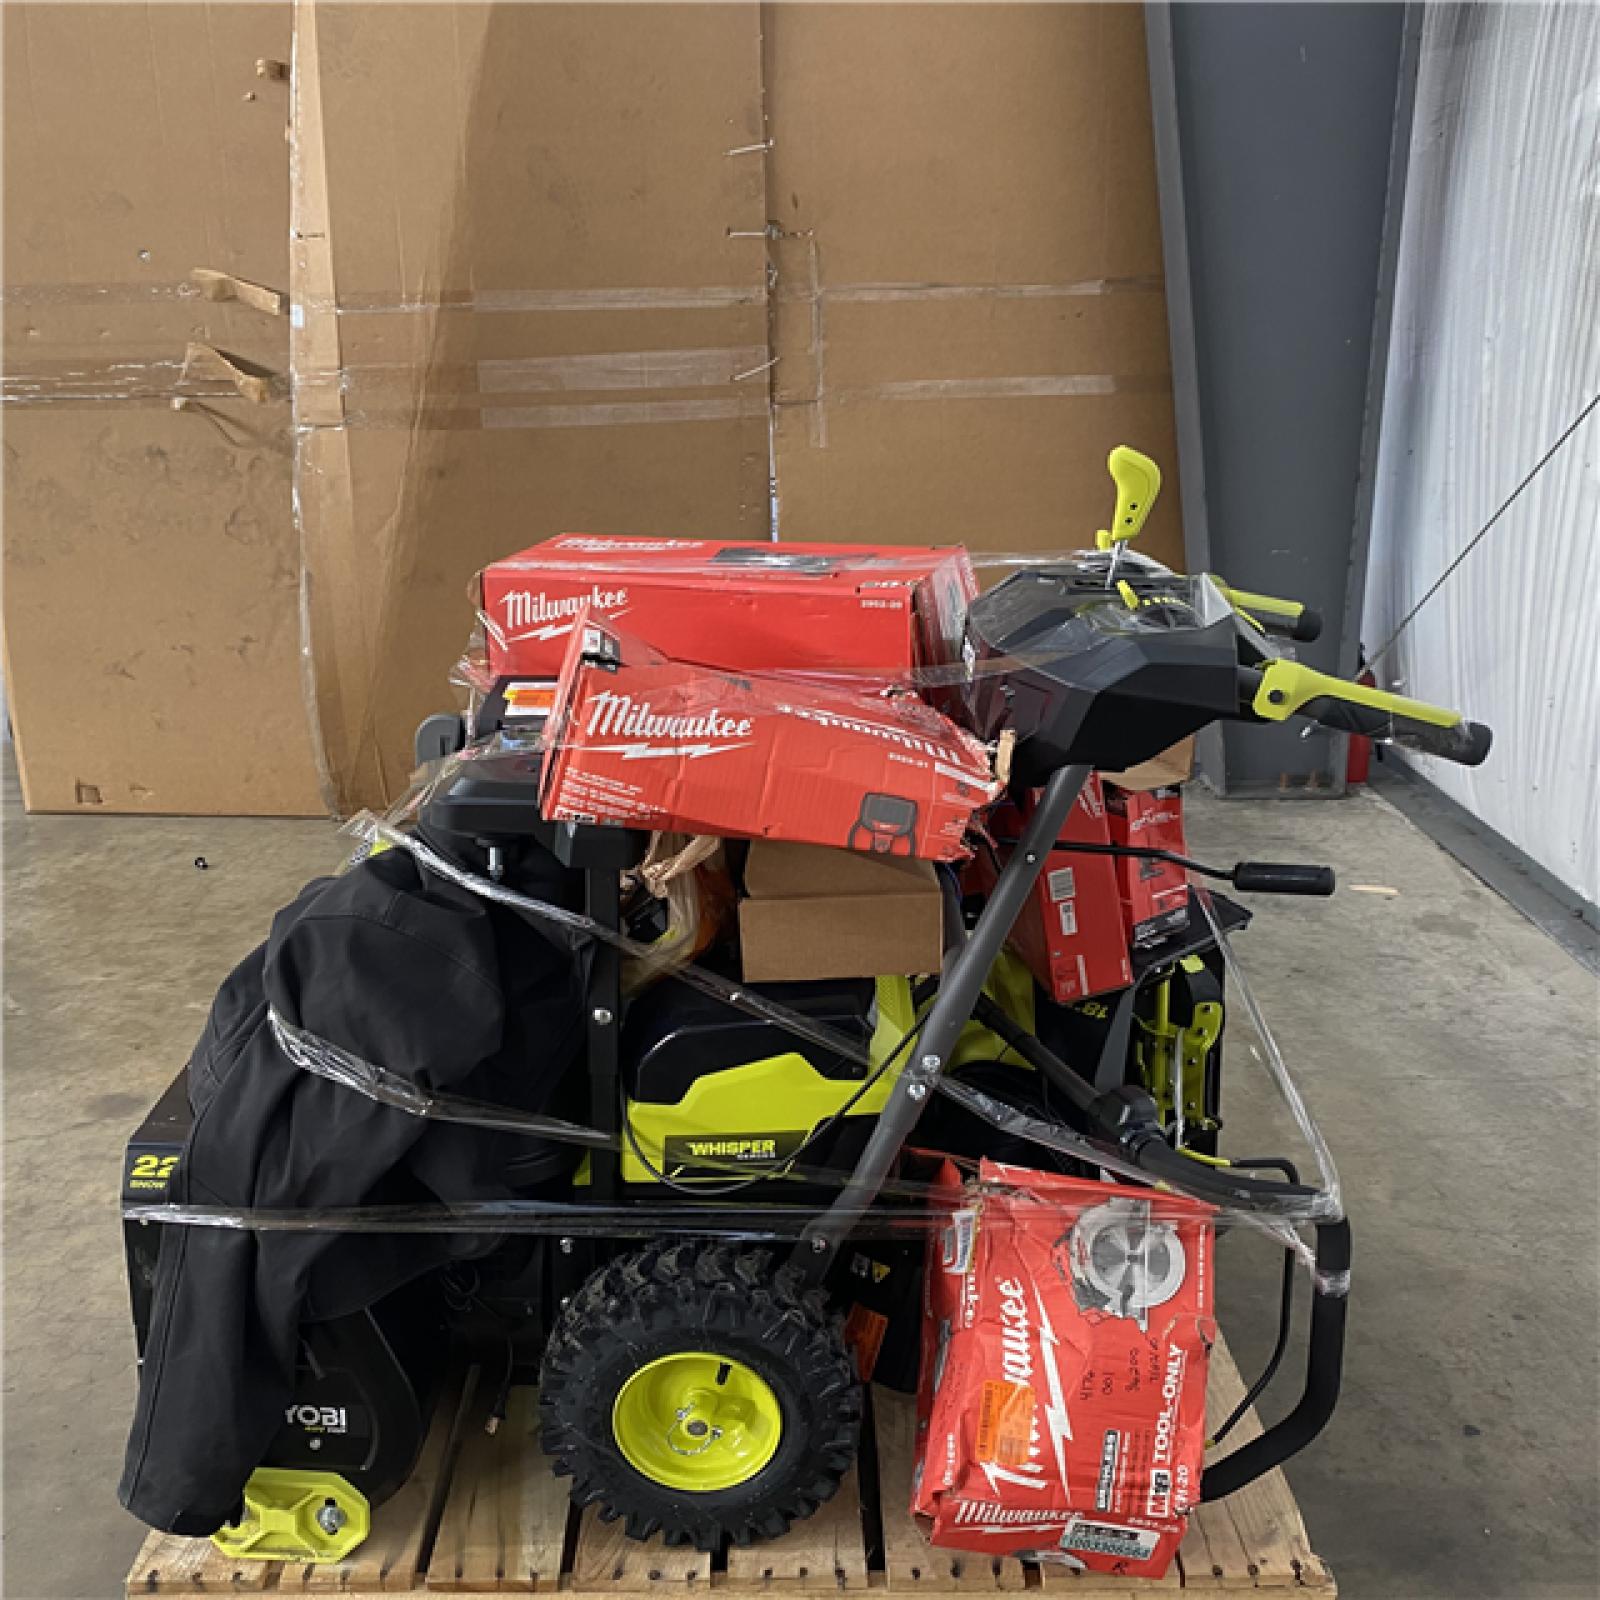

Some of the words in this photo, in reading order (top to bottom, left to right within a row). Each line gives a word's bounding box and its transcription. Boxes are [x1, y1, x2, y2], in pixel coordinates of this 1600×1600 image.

[499, 585, 628, 629] Milwaukee
[585, 690, 753, 738] Milwaukee
[687, 1139, 775, 1156] WHISPER
[285, 1405, 346, 1426] YOBI
[1153, 1344, 1183, 1462] TOOL-ONLY
